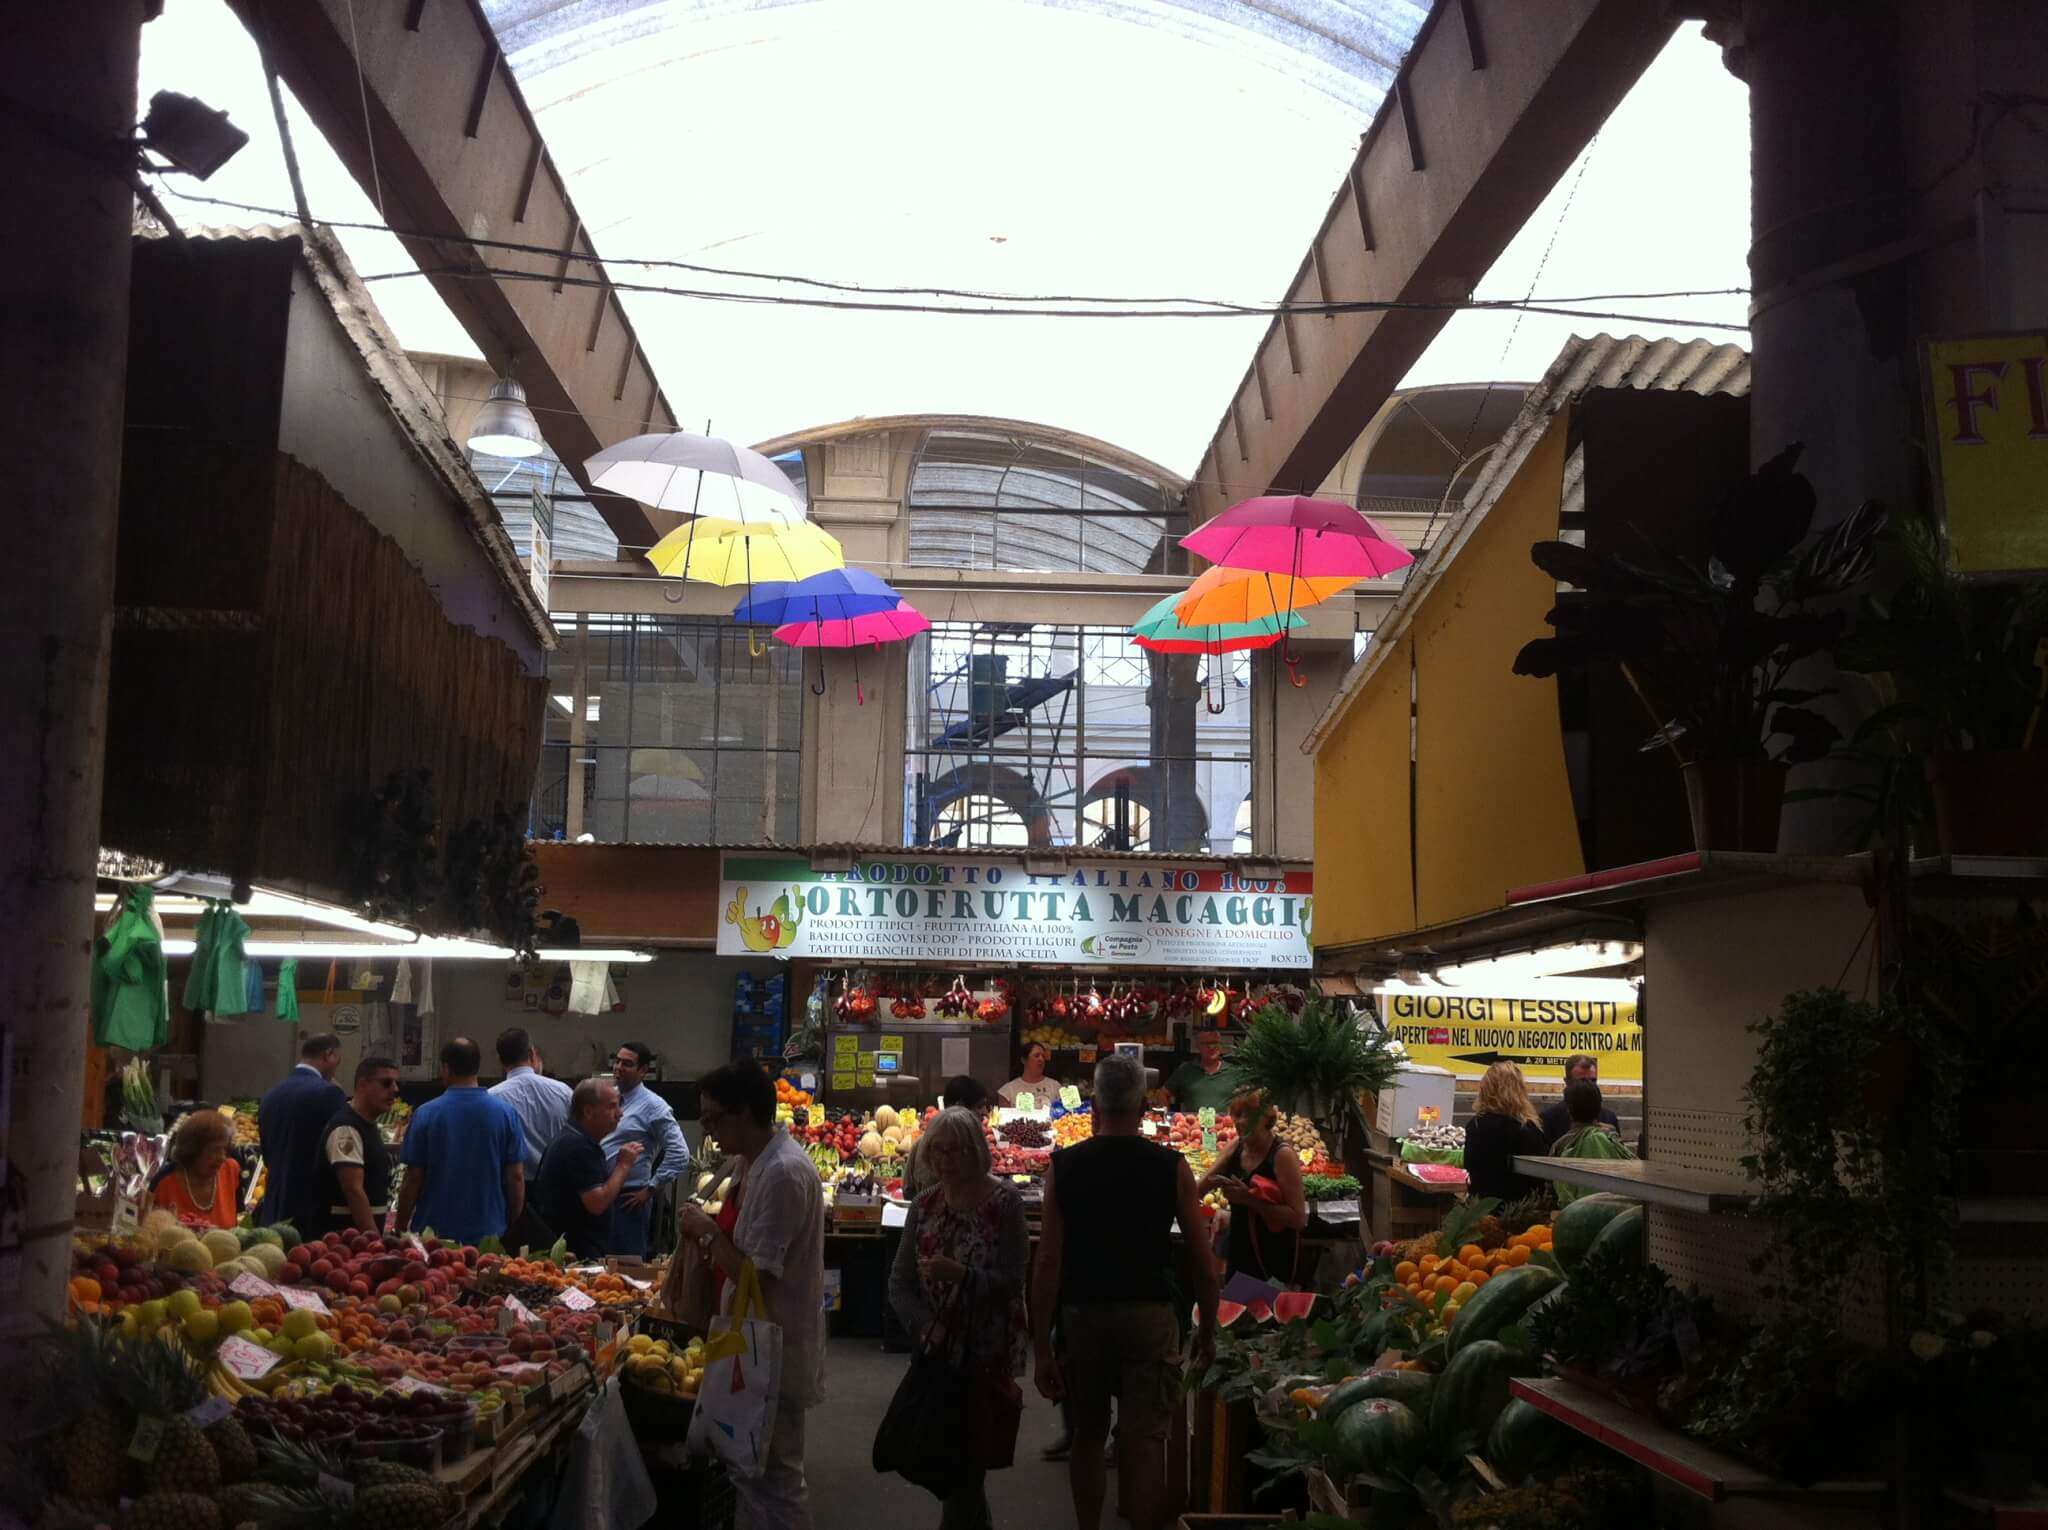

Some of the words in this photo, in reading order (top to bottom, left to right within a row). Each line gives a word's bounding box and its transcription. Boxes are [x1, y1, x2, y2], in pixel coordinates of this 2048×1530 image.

[806, 886, 1094, 921] ORTOFRUTTA
[1109, 892, 1298, 927] MACAGGI
[809, 919, 874, 930] PRODOTTI
[879, 921, 913, 931] TIPICI
[924, 922, 970, 932] FRUTTA
[973, 923, 1028, 933] ITALIANA
[1031, 925, 1044, 933] AL
[1047, 925, 1073, 934] 100%
[1146, 928, 1210, 939] CONSEGNE
[1214, 930, 1223, 939] A
[1225, 930, 1294, 941] DOMICILIO
[809, 931, 862, 942] BASILICO
[866, 932, 929, 944] GENOVESE
[932, 935, 958, 944] DOP
[968, 935, 1033, 946] PRODOTTI
[1036, 937, 1076, 947] LIGURI
[808, 944, 859, 954] TARTUFI
[863, 945, 914, 956] BIANCHI
[918, 946, 924, 956] E
[927, 947, 955, 957] NERI
[959, 948, 972, 957] DI
[976, 948, 1013, 959] PRIMA
[1016, 949, 1058, 959] SCELTA
[1394, 995, 1494, 1021] GIORGI
[1505, 1000, 1617, 1025] TESSUTI
[1451, 1027, 1471, 1046] NEL
[1475, 1028, 1513, 1048] NUOVO
[1518, 1029, 1568, 1050] NEGOZIO
[1571, 1031, 1613, 1051] DENTRO
[1615, 1033, 1629, 1051] AL
